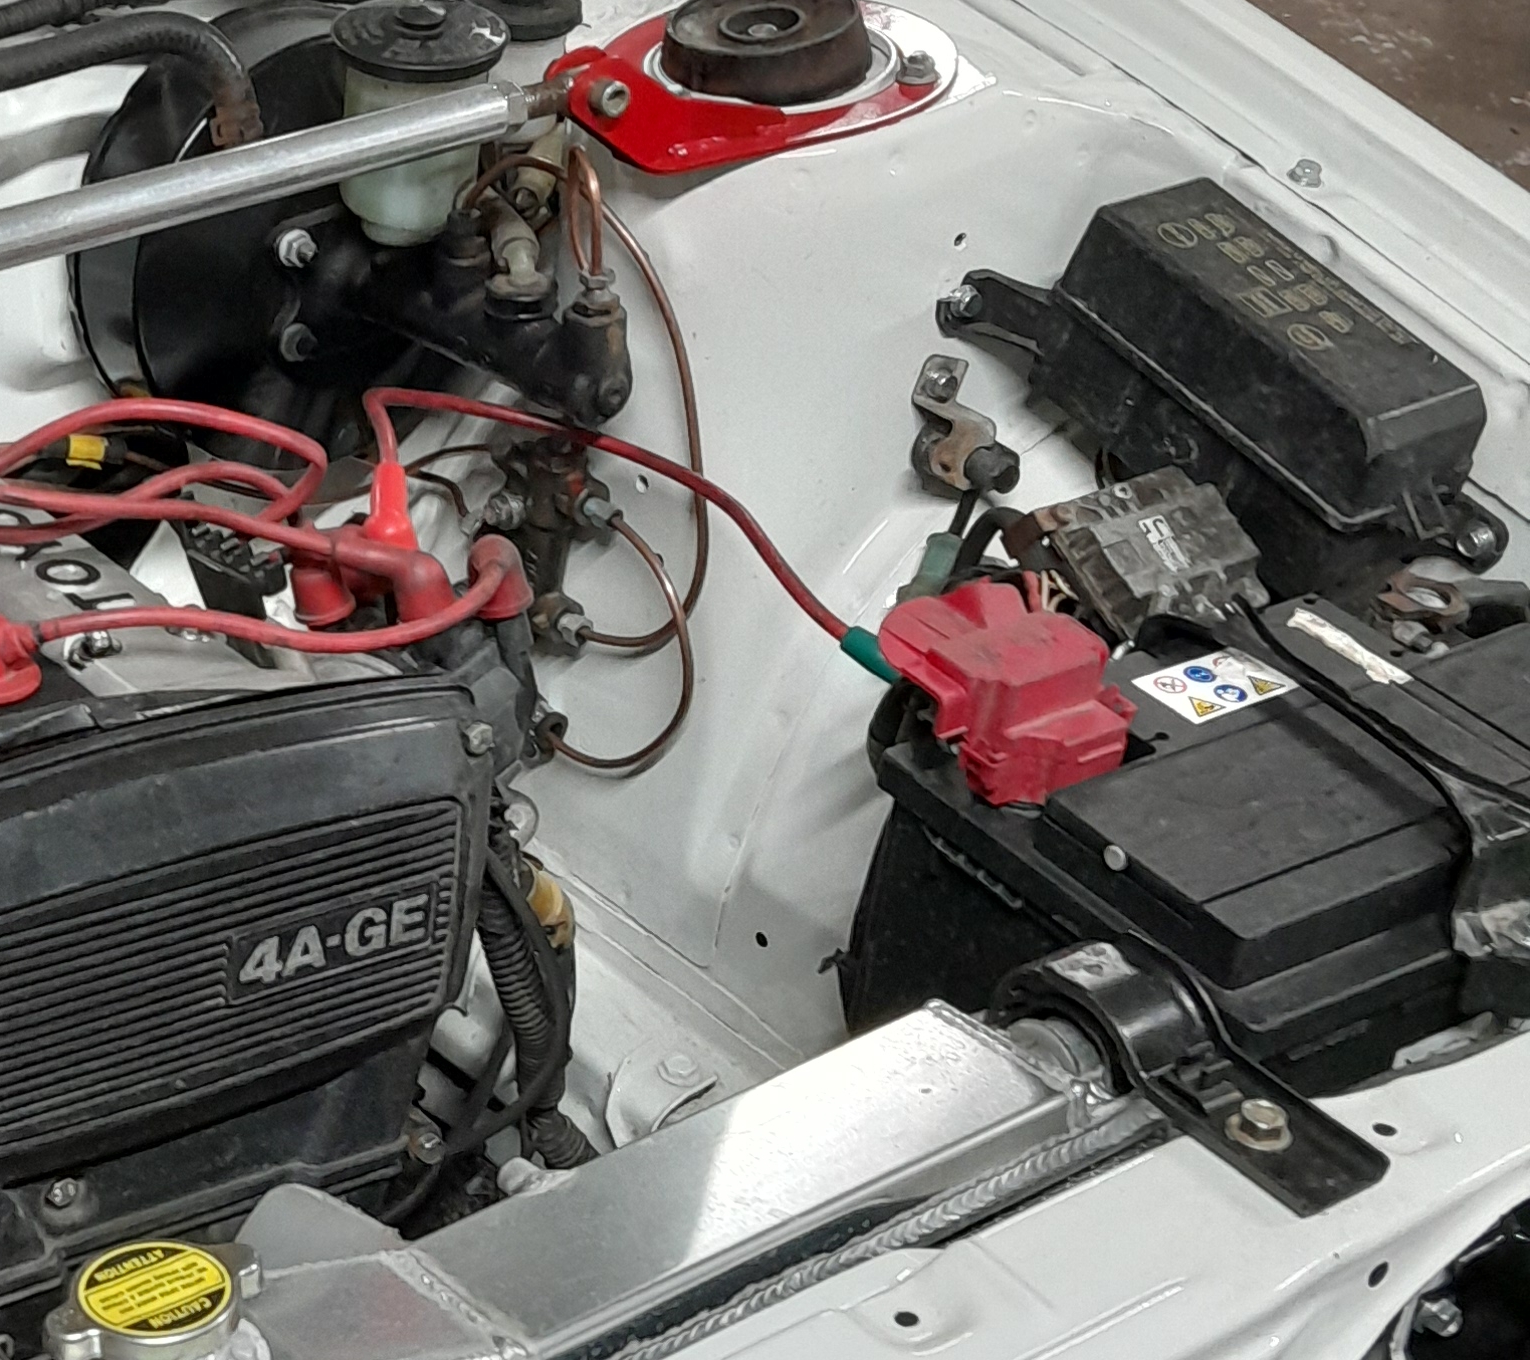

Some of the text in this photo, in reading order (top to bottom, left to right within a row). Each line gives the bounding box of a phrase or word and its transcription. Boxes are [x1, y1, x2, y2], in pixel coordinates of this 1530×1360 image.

[237, 892, 430, 986] 4A-GE
[93, 1248, 165, 1282] ATTENTION
[147, 1296, 212, 1330] CAUTION
